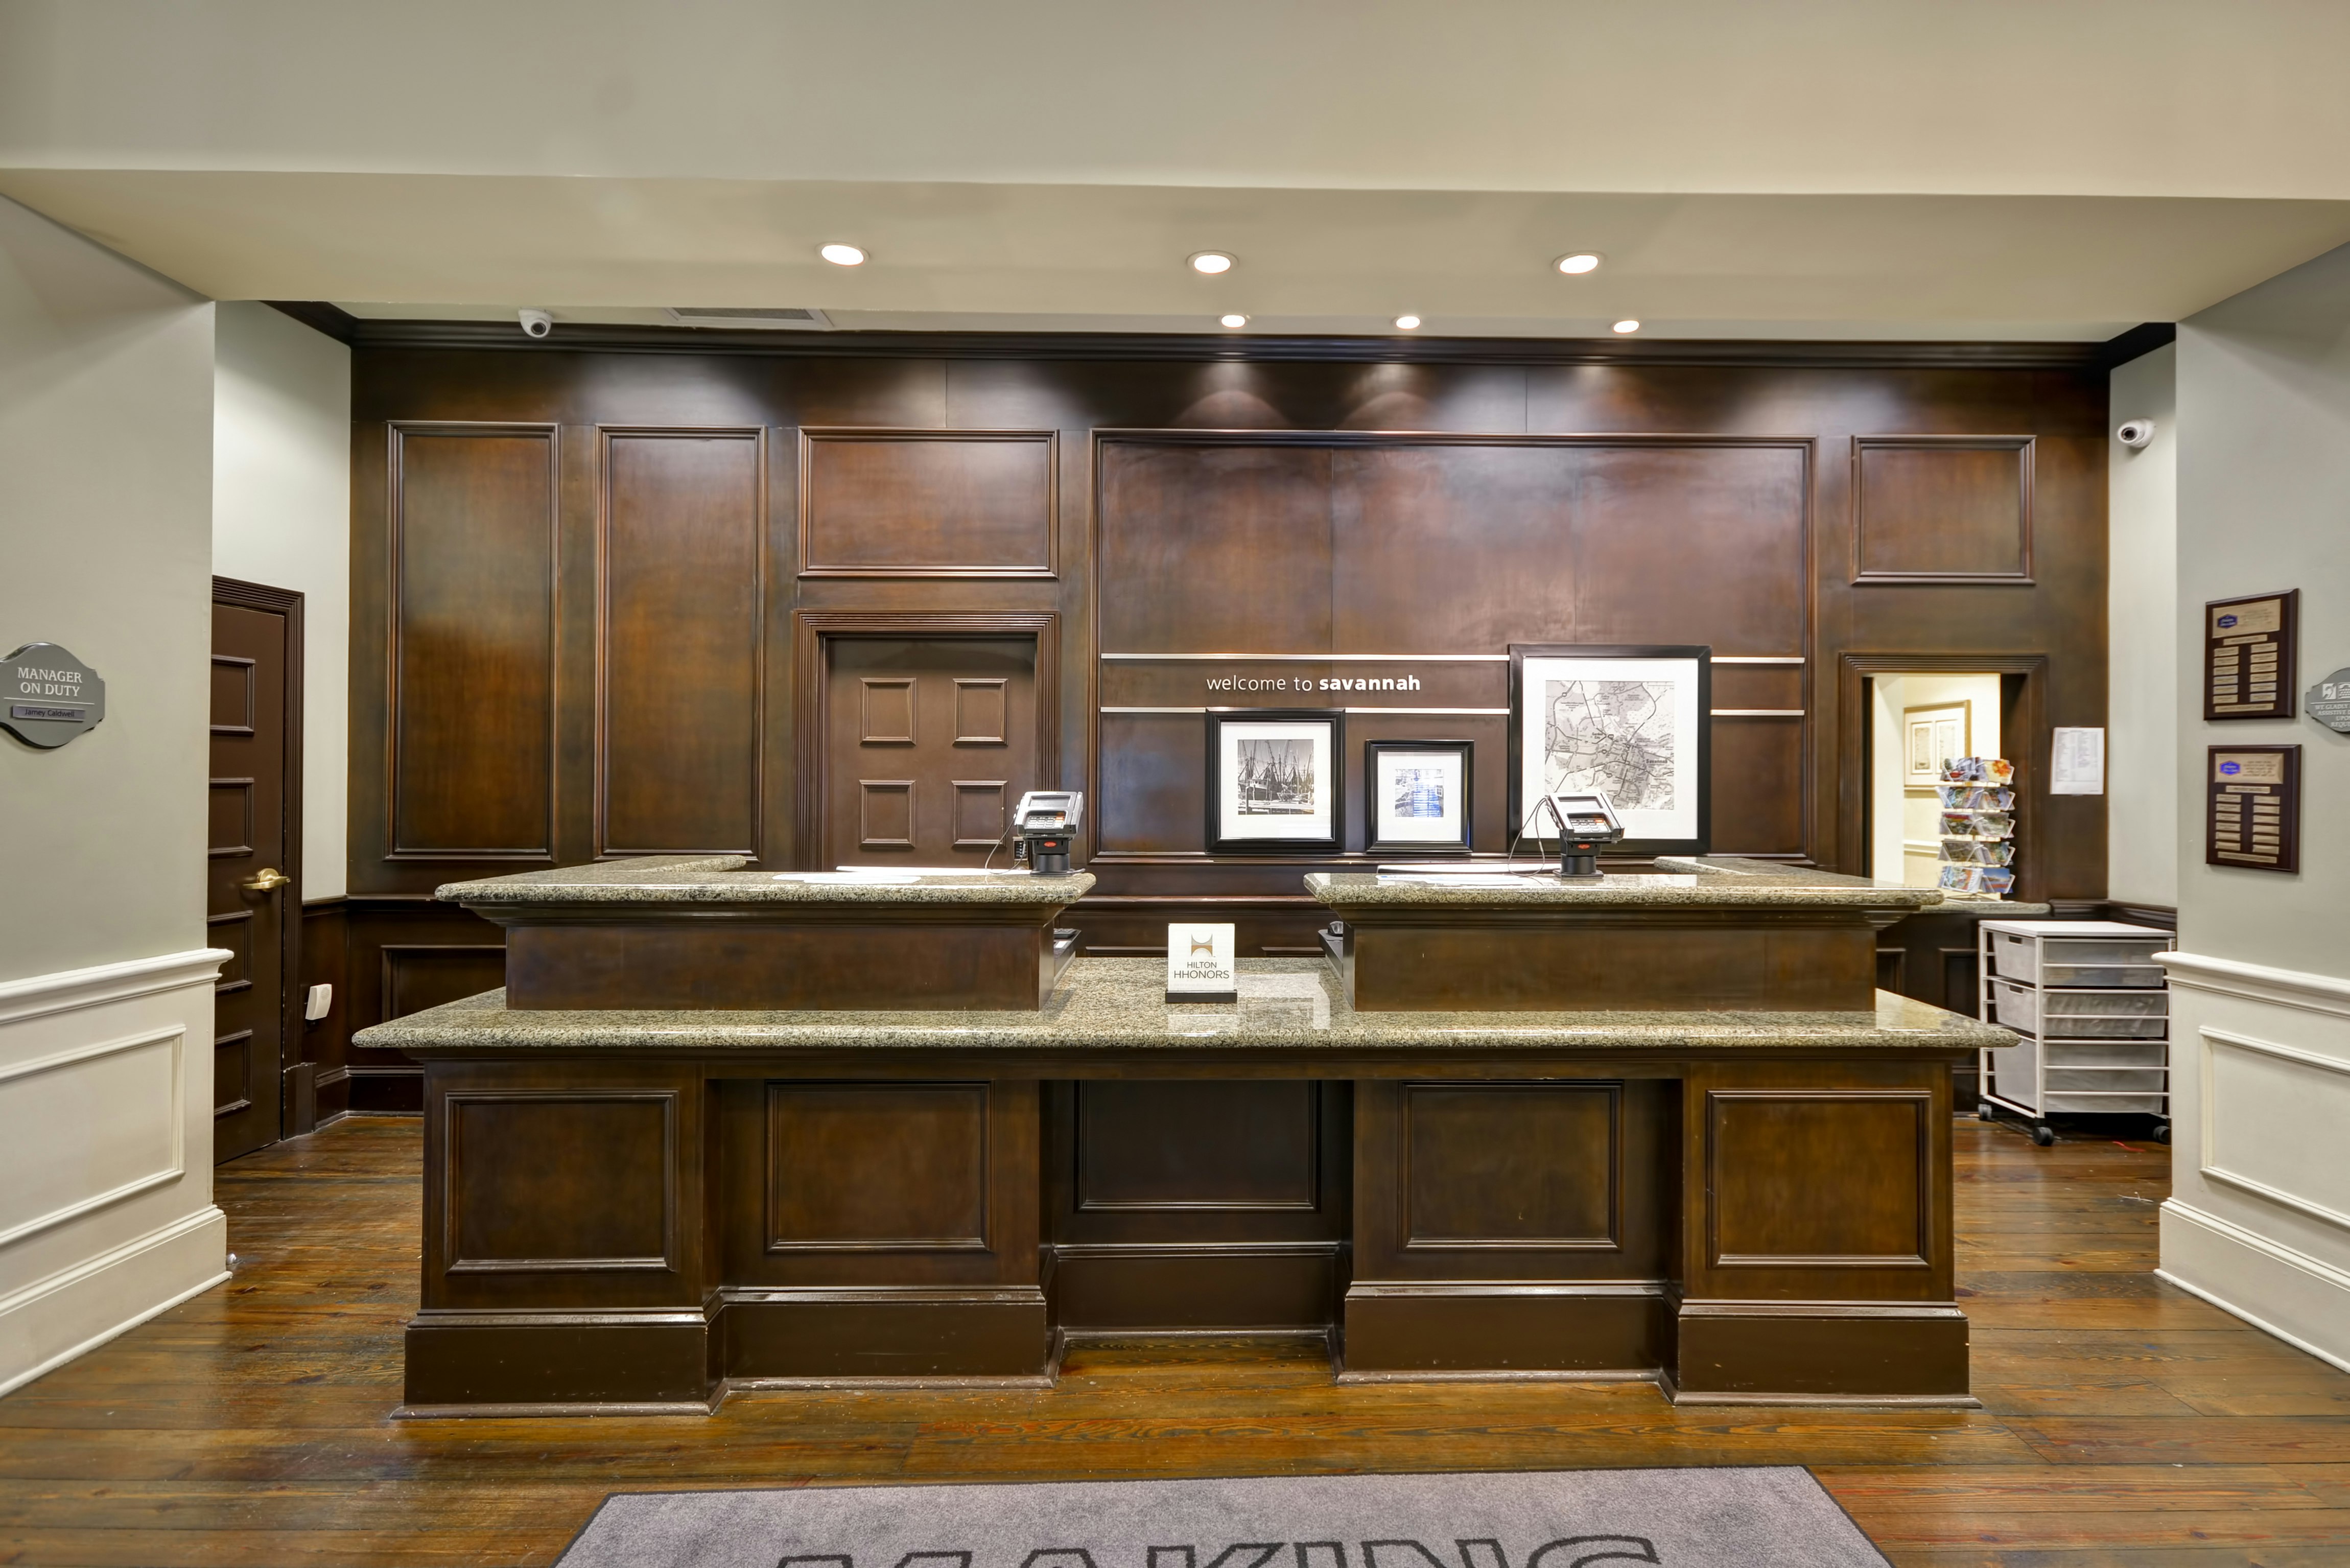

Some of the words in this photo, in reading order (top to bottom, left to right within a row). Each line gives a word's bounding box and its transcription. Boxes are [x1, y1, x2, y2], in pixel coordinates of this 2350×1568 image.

[17, 667, 83, 683] MANAGER
[20, 682, 40, 694] ON
[45, 684, 80, 696] DUTY
[1206, 675, 1286, 691] welcome
[1294, 676, 1313, 691] to
[1319, 675, 1421, 691] savannah
[25, 709, 45, 717] Jamey
[1174, 970, 1230, 979] HHONORS
